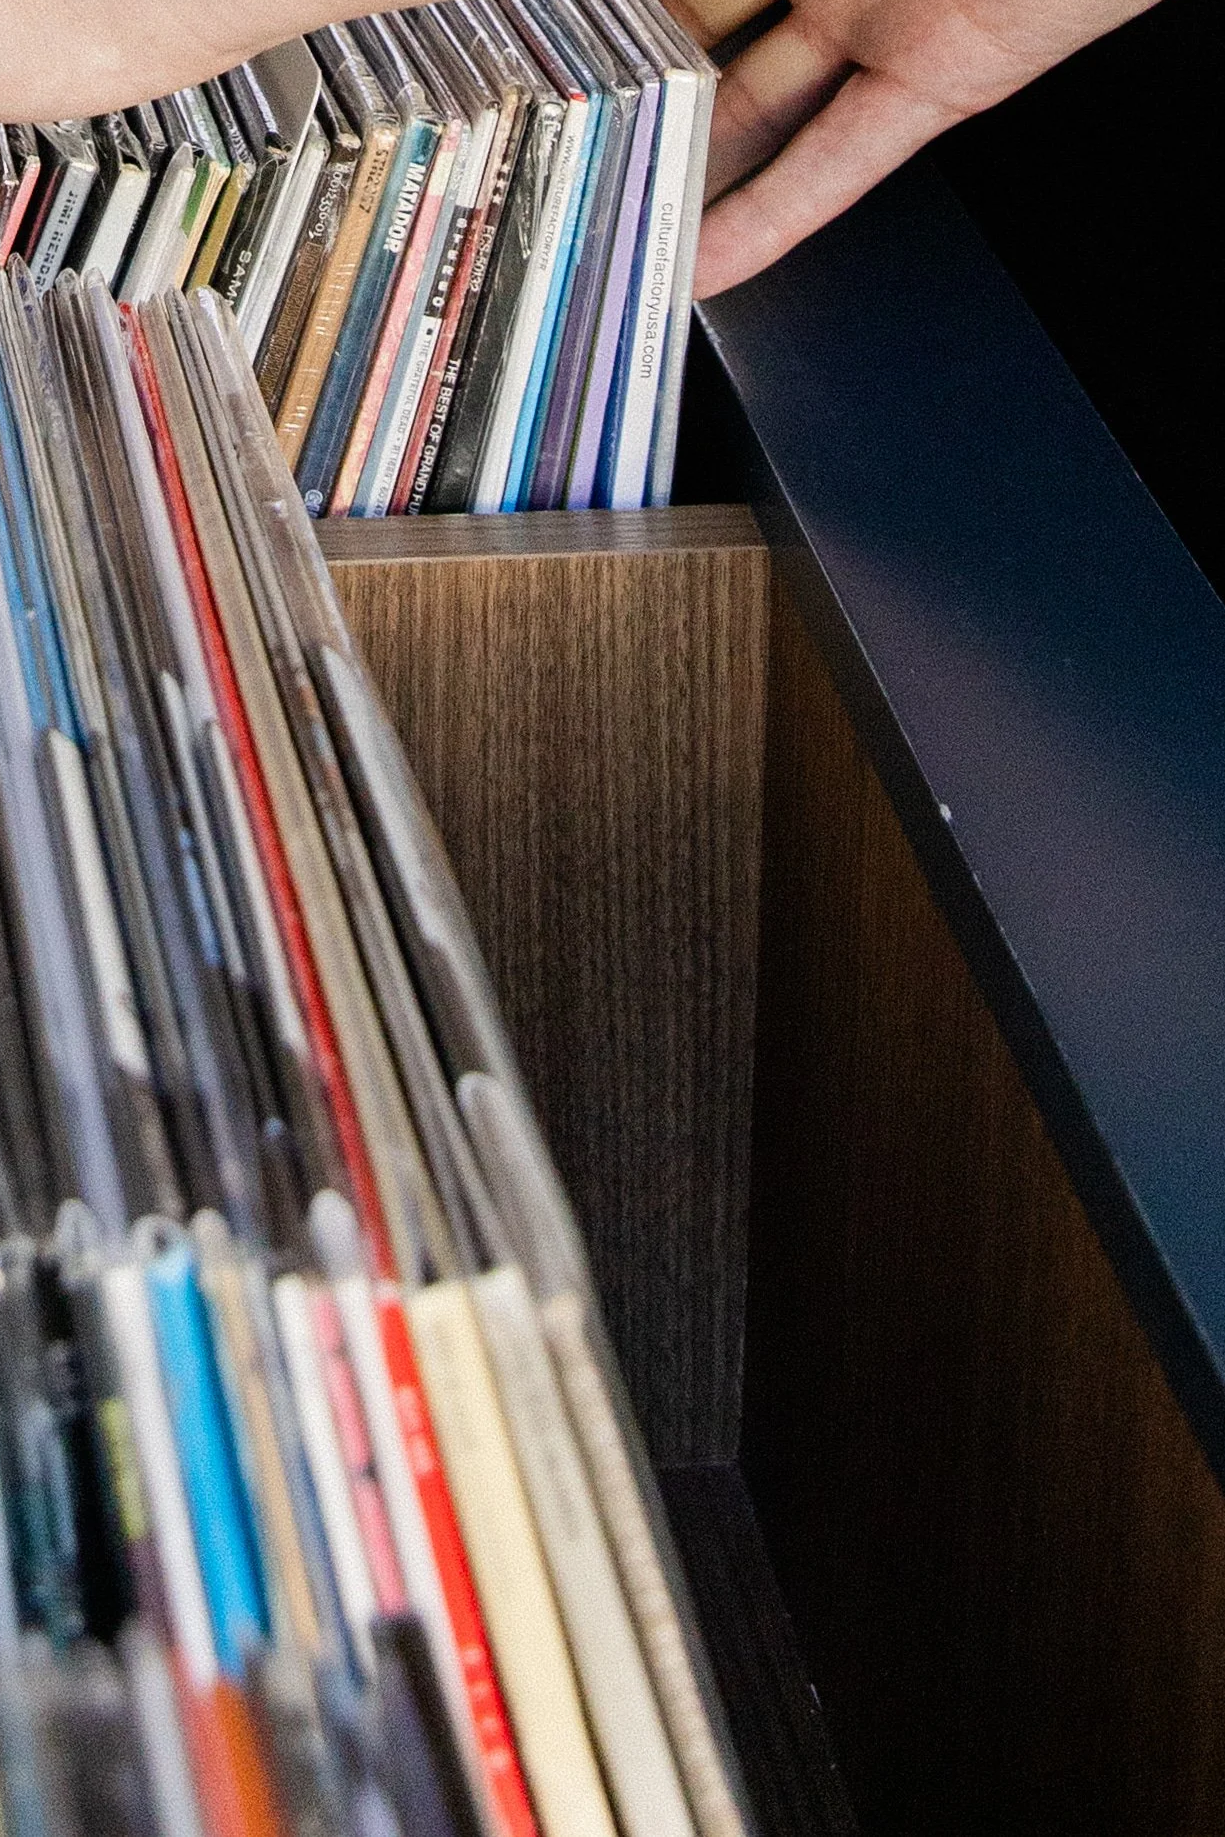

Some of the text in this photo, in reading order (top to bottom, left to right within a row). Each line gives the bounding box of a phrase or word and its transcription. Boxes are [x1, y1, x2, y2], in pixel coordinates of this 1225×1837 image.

[58, 190, 77, 225] JIMI
[383, 162, 425, 253] MATADOR
[470, 225, 495, 292] ECS-50132
[639, 202, 675, 379] culturefactoryusa.com
[443, 358, 461, 383] THE
[435, 387, 453, 420] BEST
[430, 424, 443, 443] OF
[414, 444, 436, 492] GRAND
